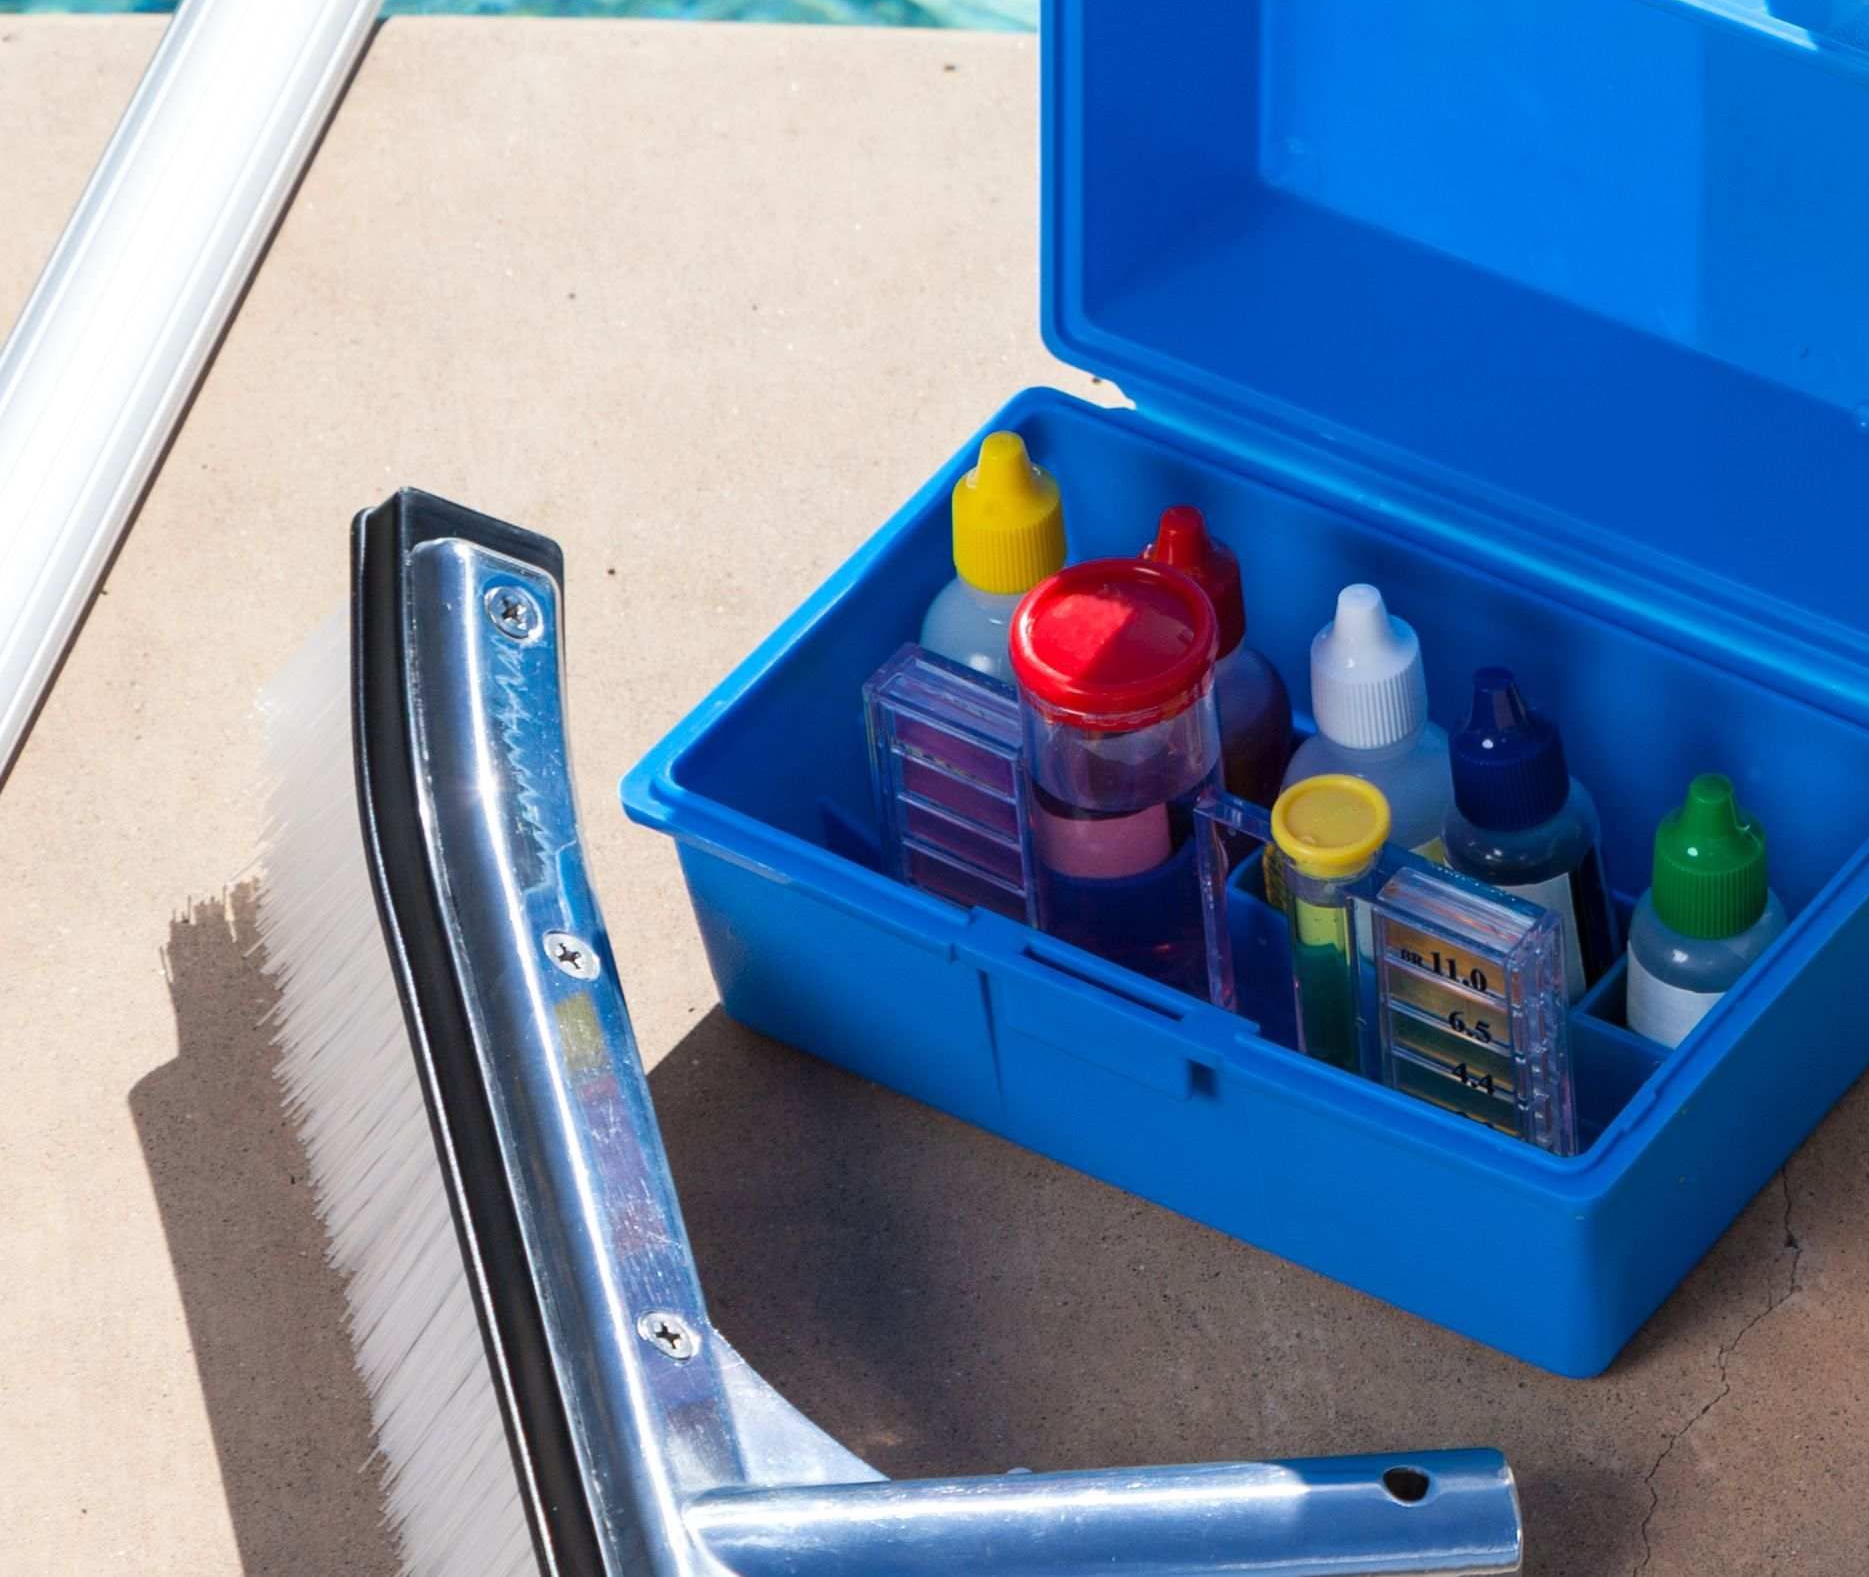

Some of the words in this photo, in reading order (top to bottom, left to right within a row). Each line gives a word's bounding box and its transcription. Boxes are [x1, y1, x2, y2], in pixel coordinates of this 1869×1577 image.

[1430, 951, 1488, 993] 11.0
[1448, 1011, 1492, 1044] 6.5
[1451, 1062, 1495, 1096] 4.4
